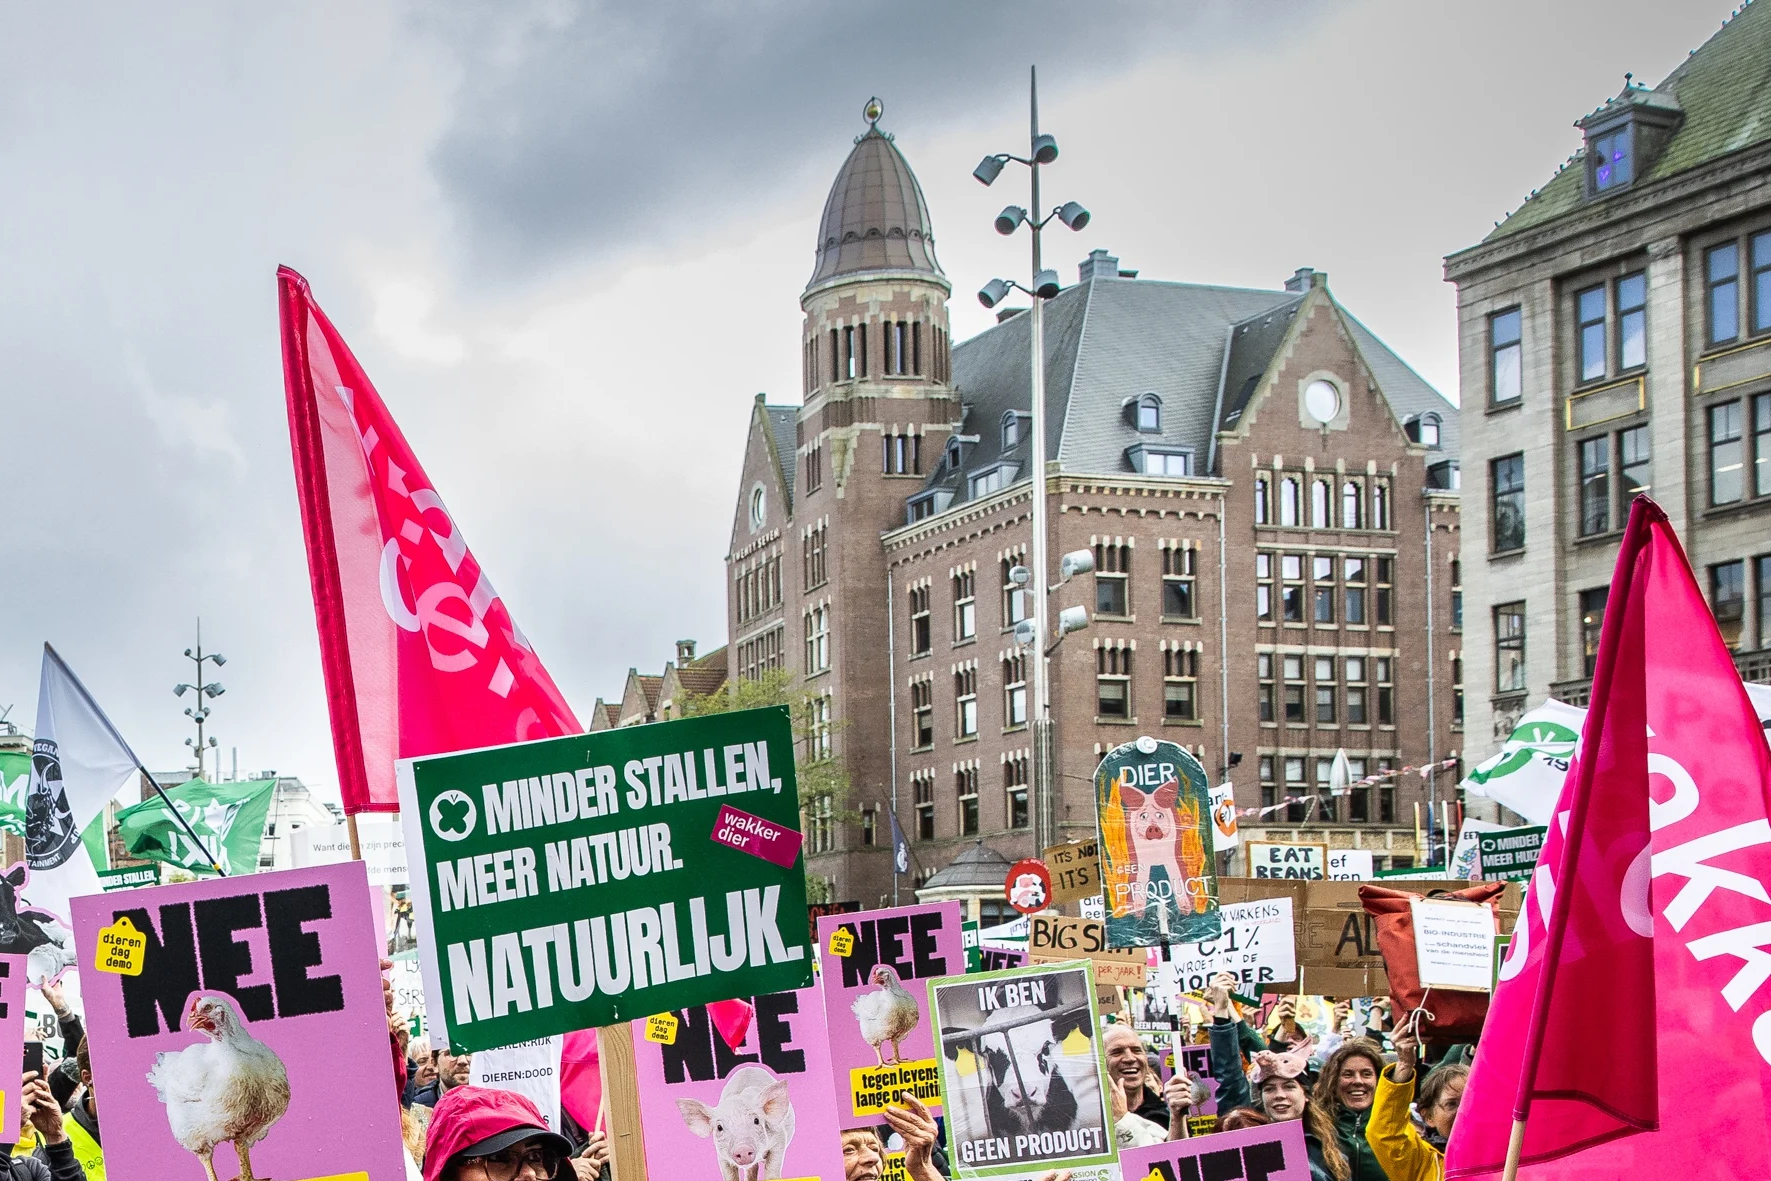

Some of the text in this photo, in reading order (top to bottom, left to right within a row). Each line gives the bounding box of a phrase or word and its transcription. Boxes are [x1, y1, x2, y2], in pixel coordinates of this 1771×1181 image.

[1118, 763, 1176, 786] DIER
[481, 739, 784, 837] MINDER STALLEN,
[723, 810, 782, 844] wakker
[313, 840, 383, 853] Want zijn
[717, 825, 751, 850] dier
[1497, 834, 1540, 851] MINDER
[1269, 847, 1314, 864] EAT
[1482, 855, 1514, 867] MEER
[436, 821, 684, 914] MEER NATUUR.
[1117, 863, 1145, 874] GEEN
[1256, 865, 1324, 880] BEANS
[1115, 876, 1213, 902] PRODUCT
[1228, 904, 1281, 922] VARKENS
[101, 931, 142, 951] dieren
[1423, 928, 1488, 940] BIO-INDUSTRIE
[110, 945, 131, 961] dag
[446, 882, 805, 1027] NATUURLIJK.
[838, 913, 947, 989] NEE
[1436, 940, 1489, 951] schandvlek
[104, 954, 133, 971] demo
[111, 883, 346, 1039] NEE
[1174, 952, 1258, 975] WROET IN DE
[977, 980, 1047, 1011] IK BEN
[648, 1016, 676, 1030] dieren
[661, 990, 807, 1084] NEE
[481, 1066, 554, 1084] DIEREN:DOOD
[861, 1066, 939, 1091] tegen levens
[856, 1089, 890, 1108] lange
[961, 1126, 1103, 1164] GEEN PRODUCT
